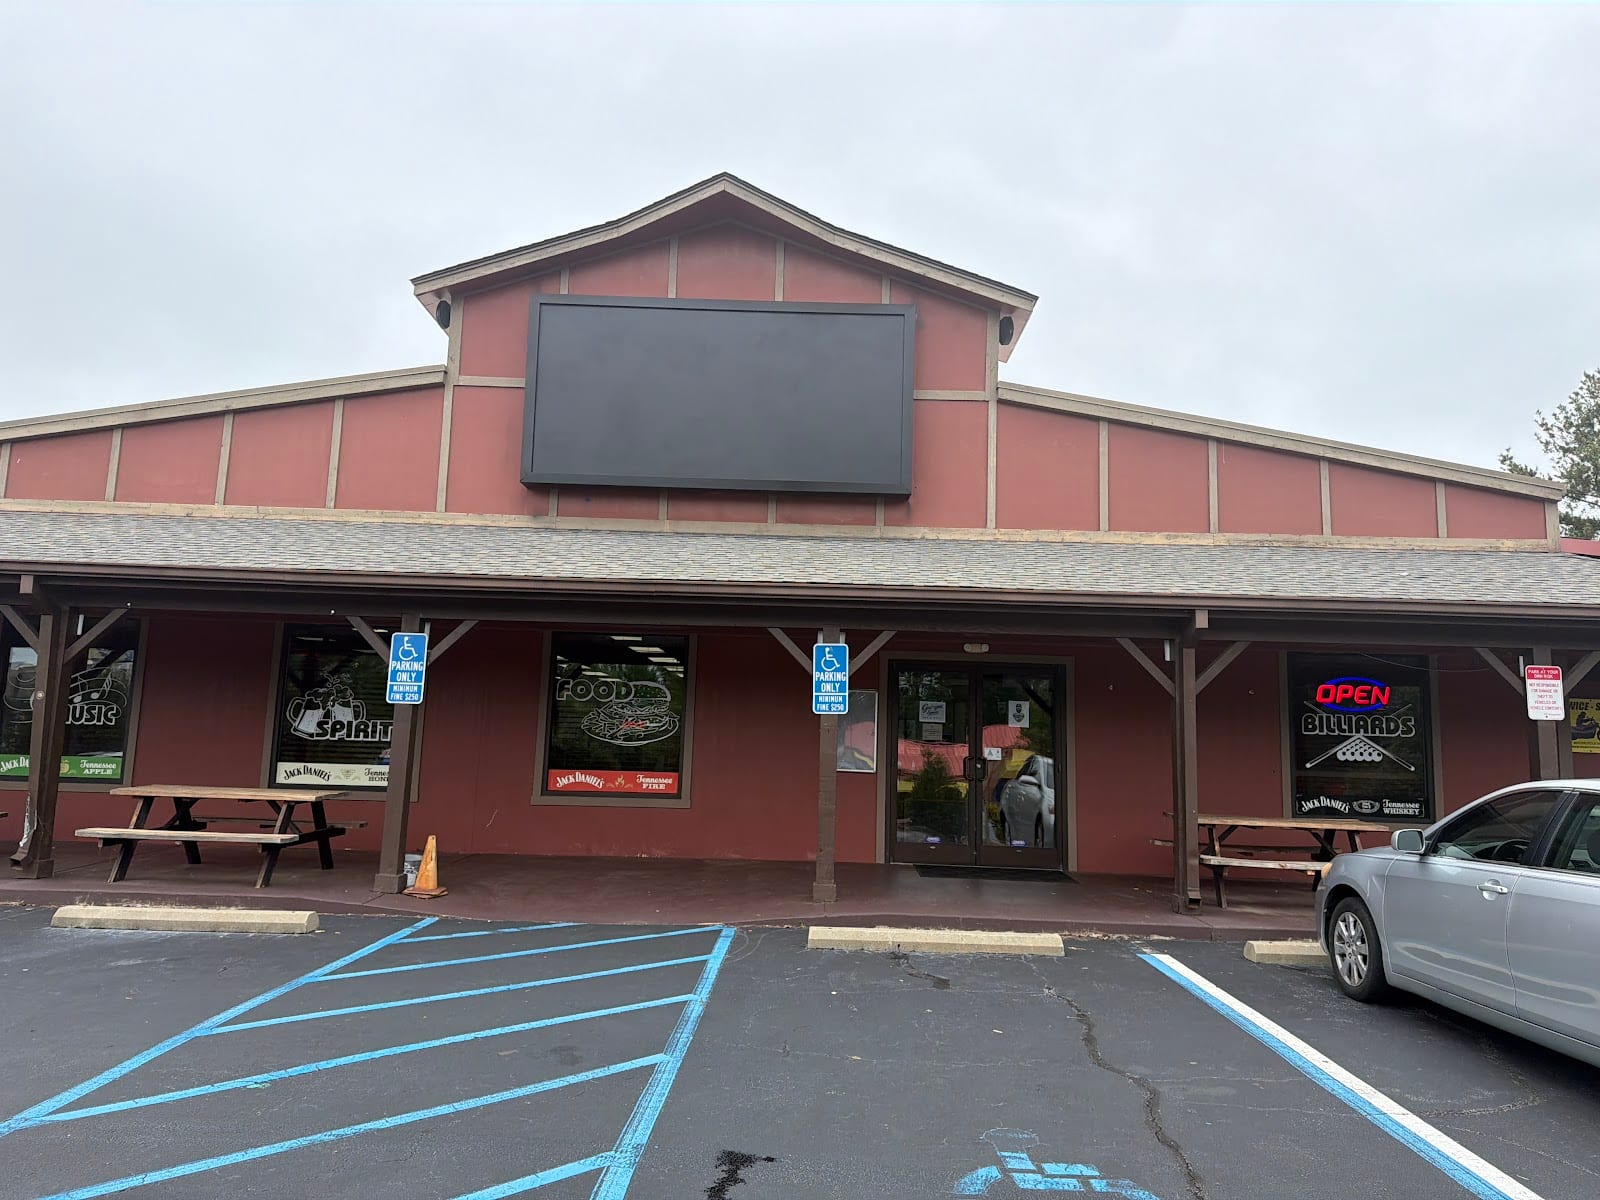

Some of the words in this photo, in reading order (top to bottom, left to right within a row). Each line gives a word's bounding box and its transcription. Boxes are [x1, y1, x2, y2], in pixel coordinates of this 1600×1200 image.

[391, 661, 424, 671] PARKING
[396, 671, 417, 682] ONLY
[815, 671, 846, 682] PARKING
[392, 685, 418, 693] MINIMUM
[556, 679, 634, 702] FOOD
[821, 682, 840, 693] ONLY
[405, 693, 419, 701] $250
[1316, 684, 1391, 705] OPEN
[816, 703, 830, 711] FINE
[830, 703, 844, 711] $250
[65, 704, 121, 725] USIC
[1302, 713, 1416, 738] BILLIARDS
[0, 759, 19, 773] JACK
[80, 759, 117, 769] Tennessee
[284, 767, 302, 780] JACK
[303, 765, 332, 782] DANIEL'S
[636, 774, 673, 784] Tennessee
[556, 773, 575, 788] JACK
[575, 771, 605, 789] DANIEL'S
[1301, 798, 1320, 813] JACK
[1319, 795, 1350, 814] DANIEL'S
[1382, 799, 1420, 809] Tennessee
[1382, 807, 1420, 815] WHISKEY
